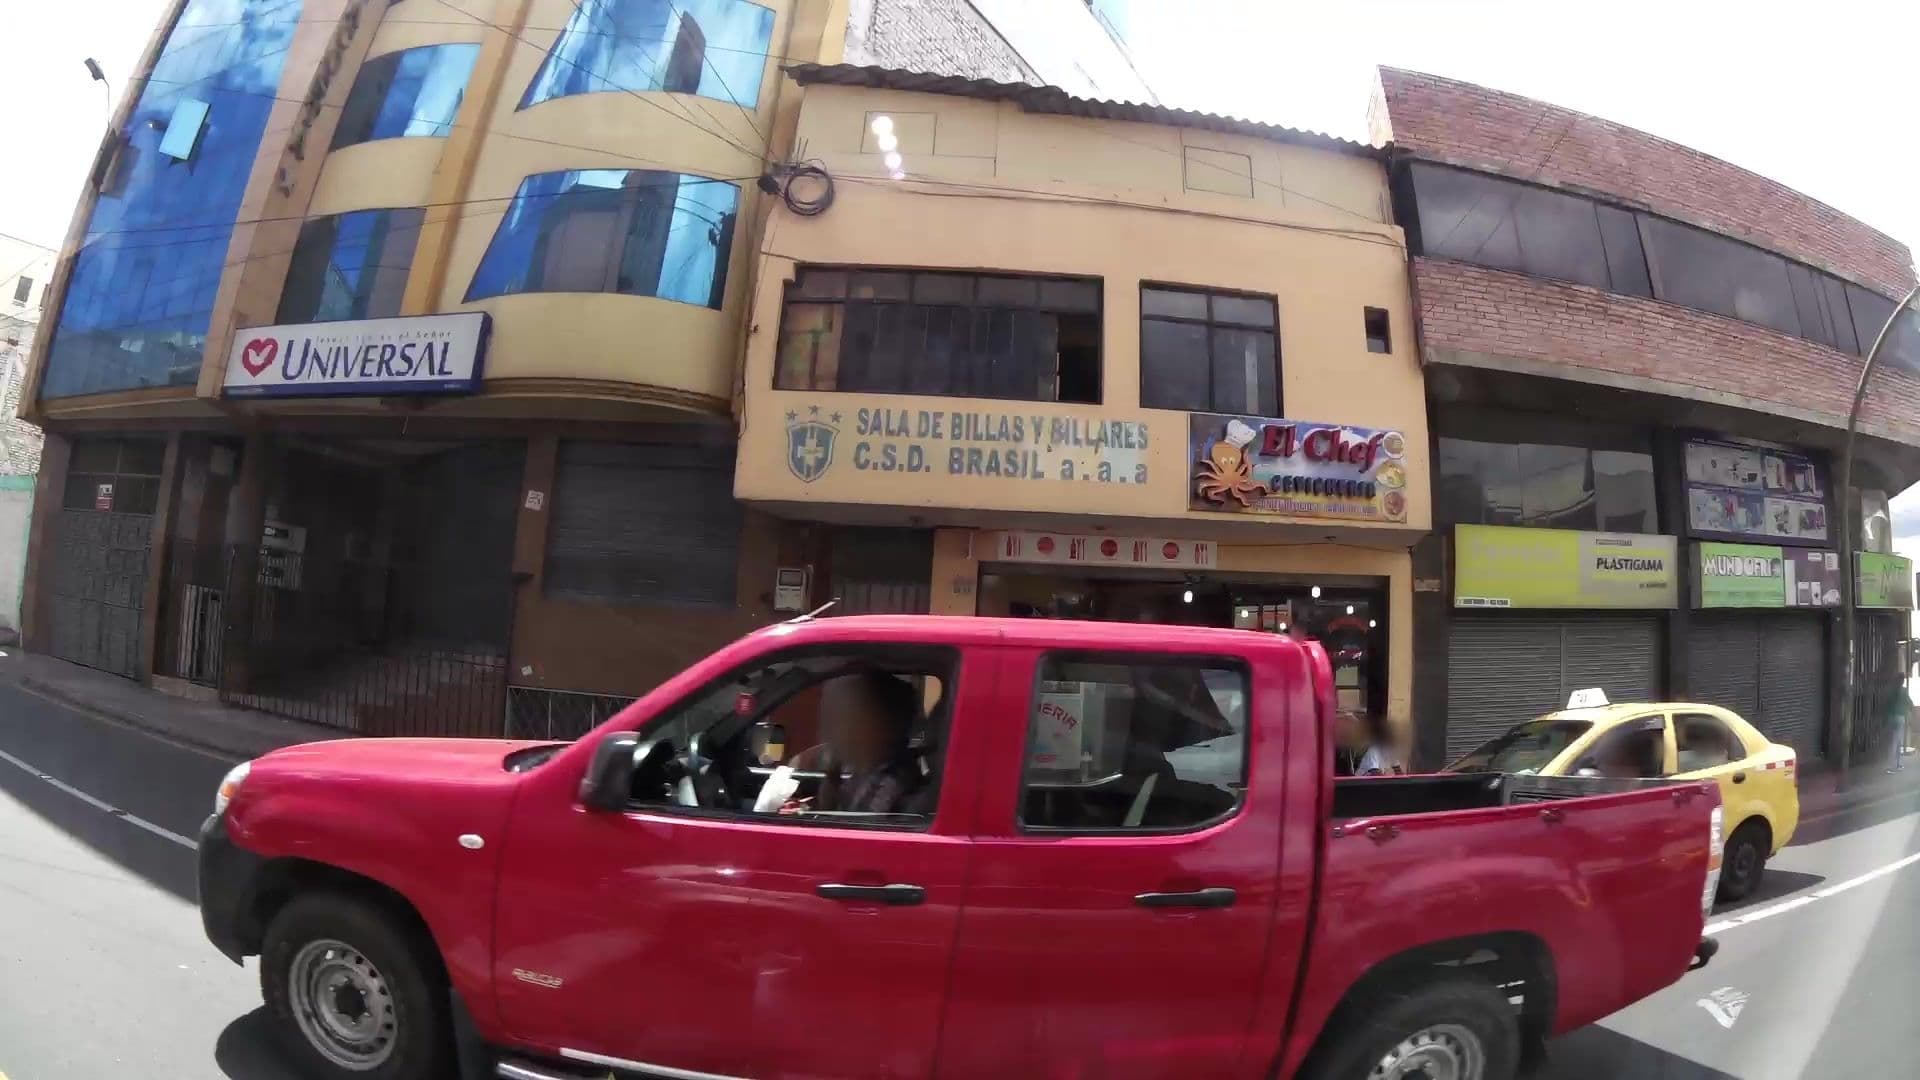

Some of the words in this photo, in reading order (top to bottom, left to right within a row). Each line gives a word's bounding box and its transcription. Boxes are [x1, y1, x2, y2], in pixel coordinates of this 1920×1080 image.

[856, 407, 910, 438] SALA
[917, 410, 944, 439] DE
[951, 412, 1025, 443] BILLAS
[1030, 415, 1044, 444] Y
[1051, 416, 1148, 450] BILLARES
[1259, 423, 1298, 457] El
[1302, 425, 1385, 474] Chef
[854, 441, 931, 473] C.S.D.
[949, 446, 1045, 479] BRASIL
[1595, 557, 1664, 572] PLASTIGAMA
